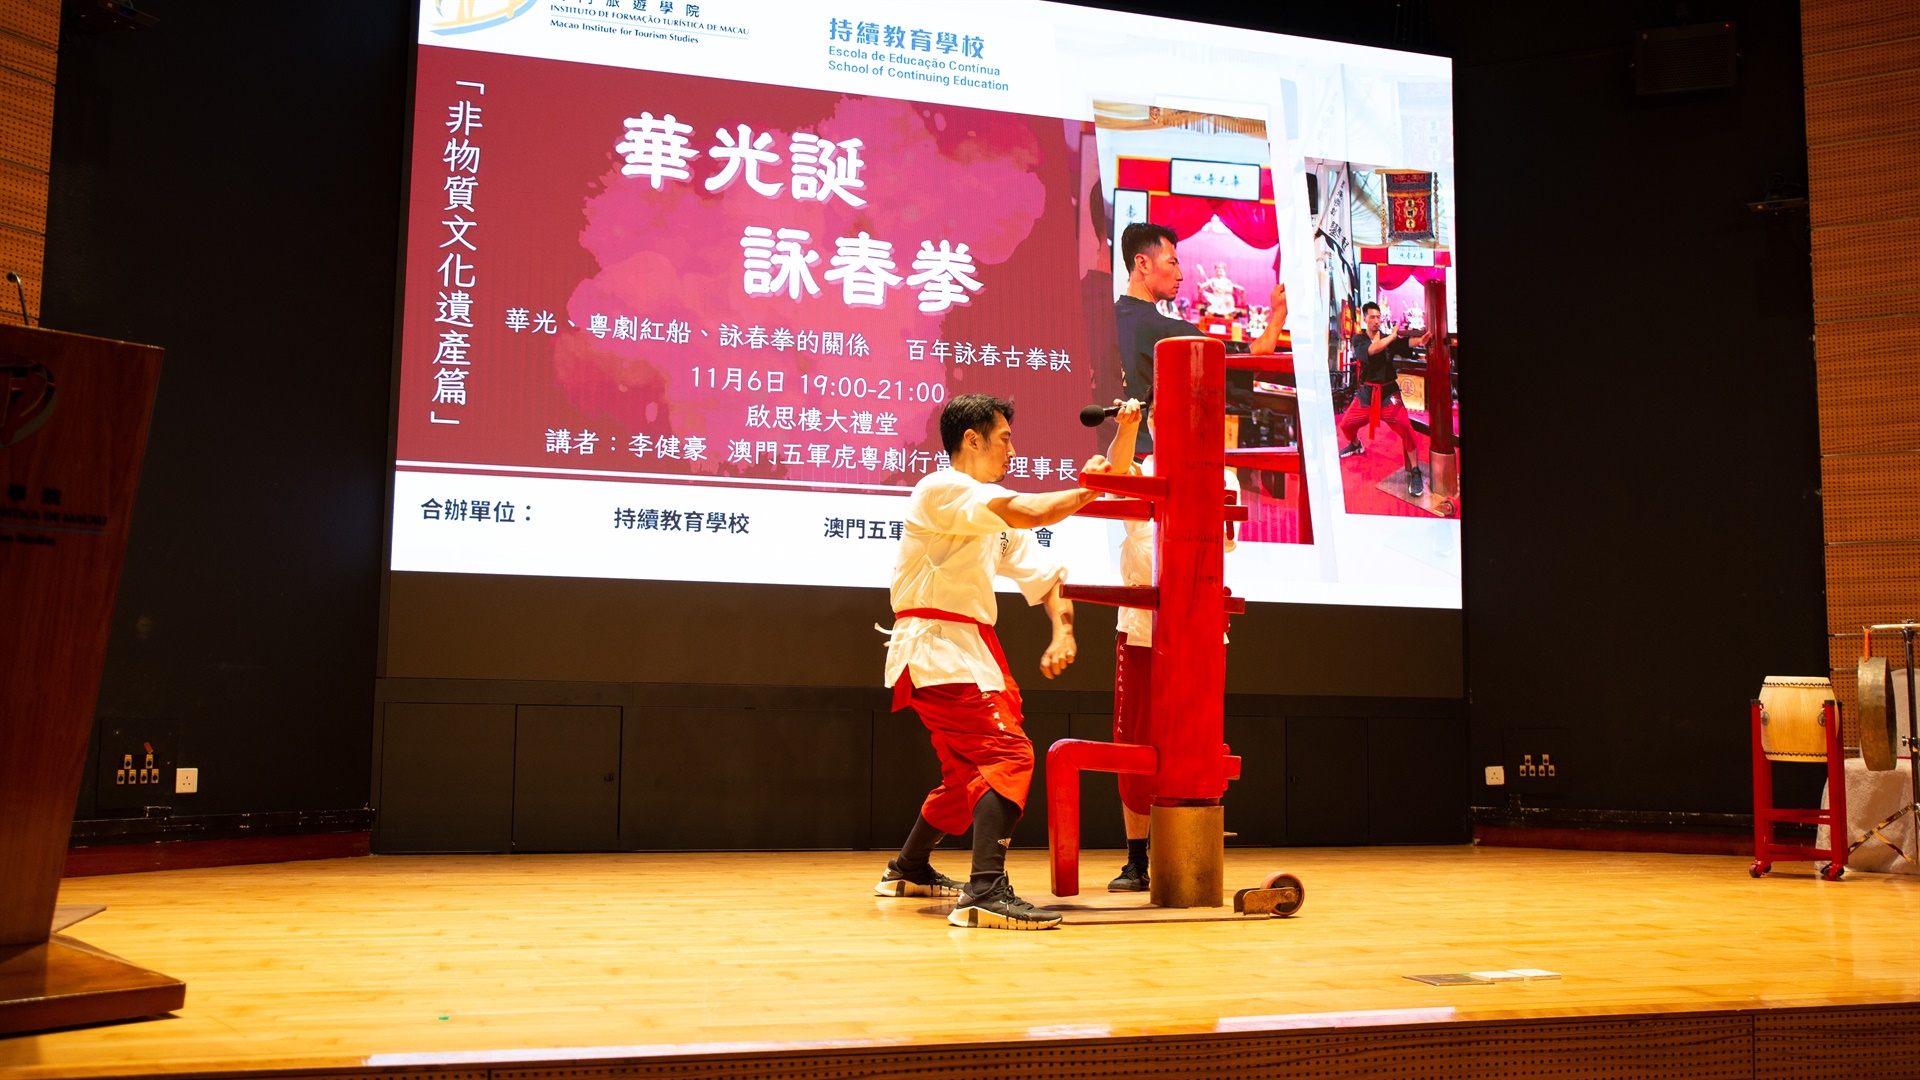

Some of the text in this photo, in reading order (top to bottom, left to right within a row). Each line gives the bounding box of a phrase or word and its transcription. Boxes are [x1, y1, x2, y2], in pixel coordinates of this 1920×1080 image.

[550, 4, 750, 35] INSTITUTO DE FORMAÇÃO TURÍSTICA DE MACAU
[550, 19, 699, 43] Macao Institute for Tourism Studies
[829, 17, 985, 59] 持續教育學校
[828, 60, 1009, 91] School of Continuing Education
[829, 45, 1001, 76] Escola de Educação Contínua
[615, 111, 868, 207] 華光誕
[740, 225, 984, 312] 詠春拳
[906, 338, 1072, 373] 百年詠春古拳訣
[691, 366, 945, 404] 11月6日 19:00-21:00
[746, 403, 899, 436] 啟思樓大禮堂
[614, 507, 750, 534] 持續教育學校
